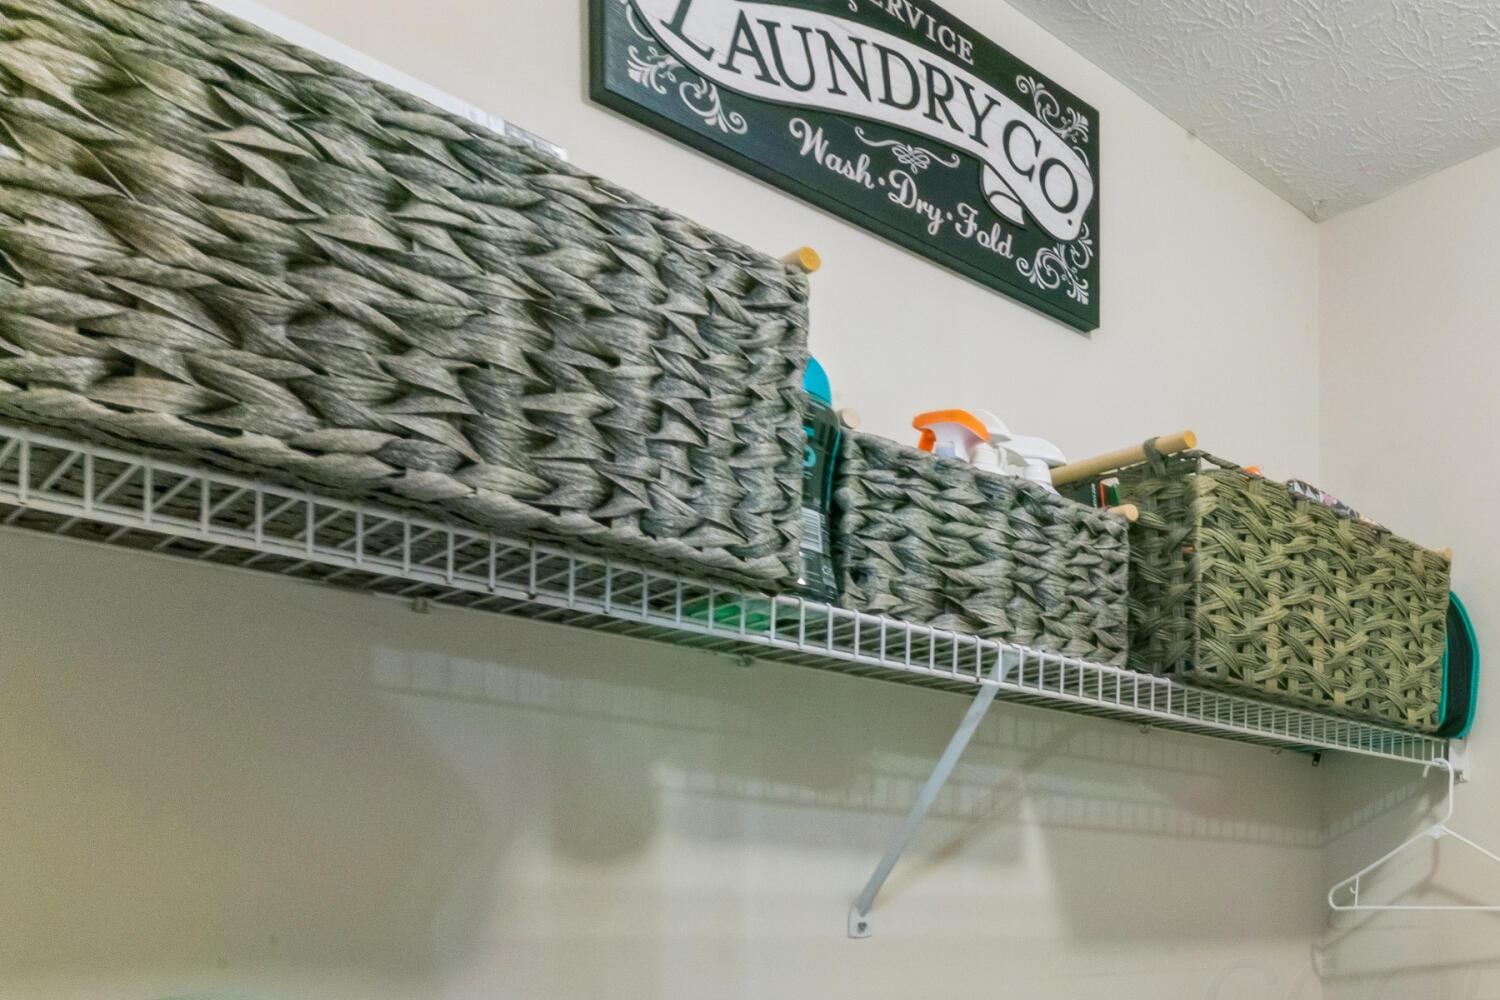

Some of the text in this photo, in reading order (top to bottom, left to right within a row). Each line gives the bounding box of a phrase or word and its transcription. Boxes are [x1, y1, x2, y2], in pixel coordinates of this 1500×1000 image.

[789, 117, 1013, 260] Wash Dry Fold
[1002, 119, 1079, 214] CO
